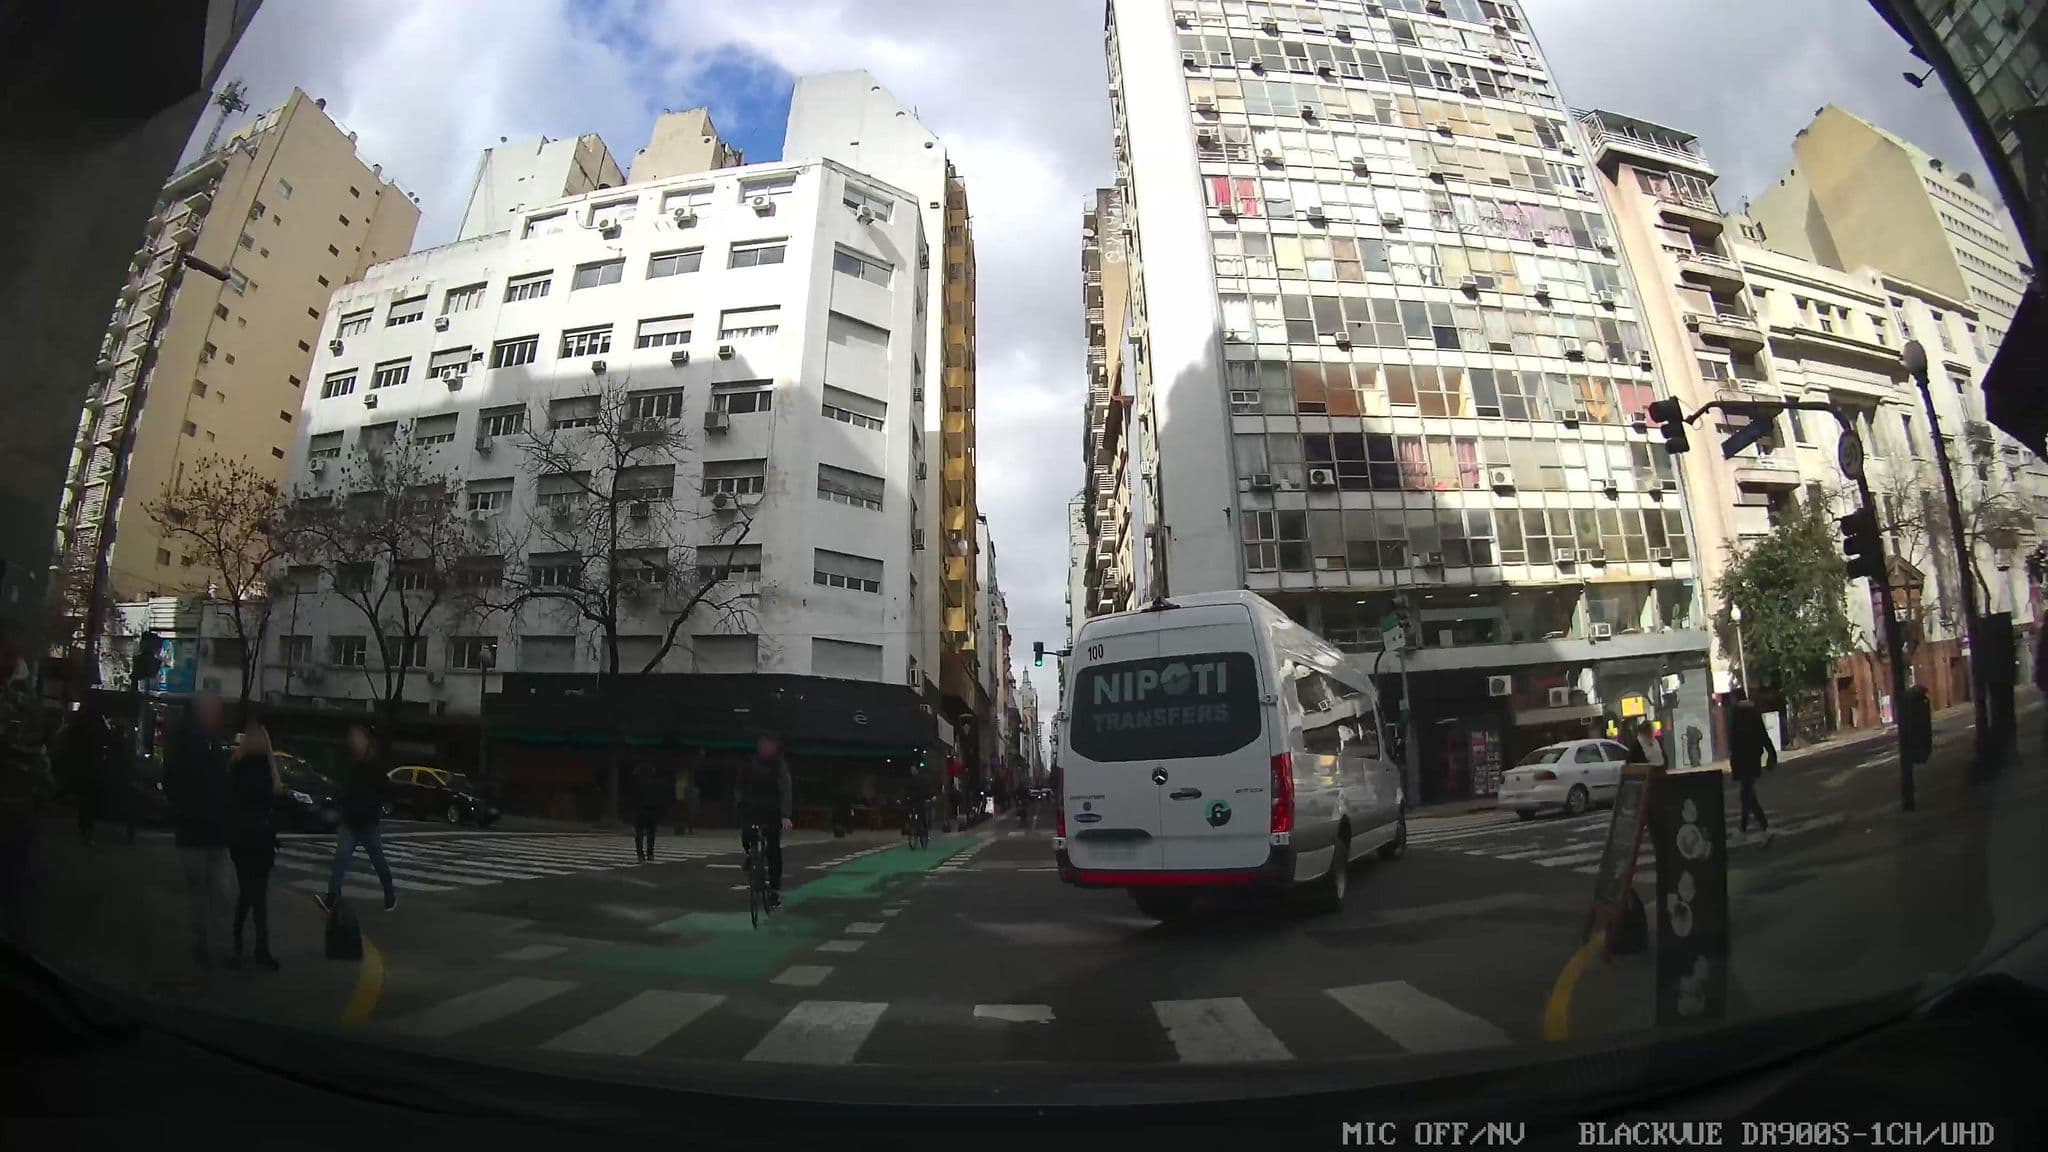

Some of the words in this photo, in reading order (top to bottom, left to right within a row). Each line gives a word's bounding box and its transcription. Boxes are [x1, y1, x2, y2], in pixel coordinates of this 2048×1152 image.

[1087, 644, 1104, 661] 100
[1094, 662, 1227, 704] NIPOTI
[1093, 703, 1229, 732] TRANSFERS
